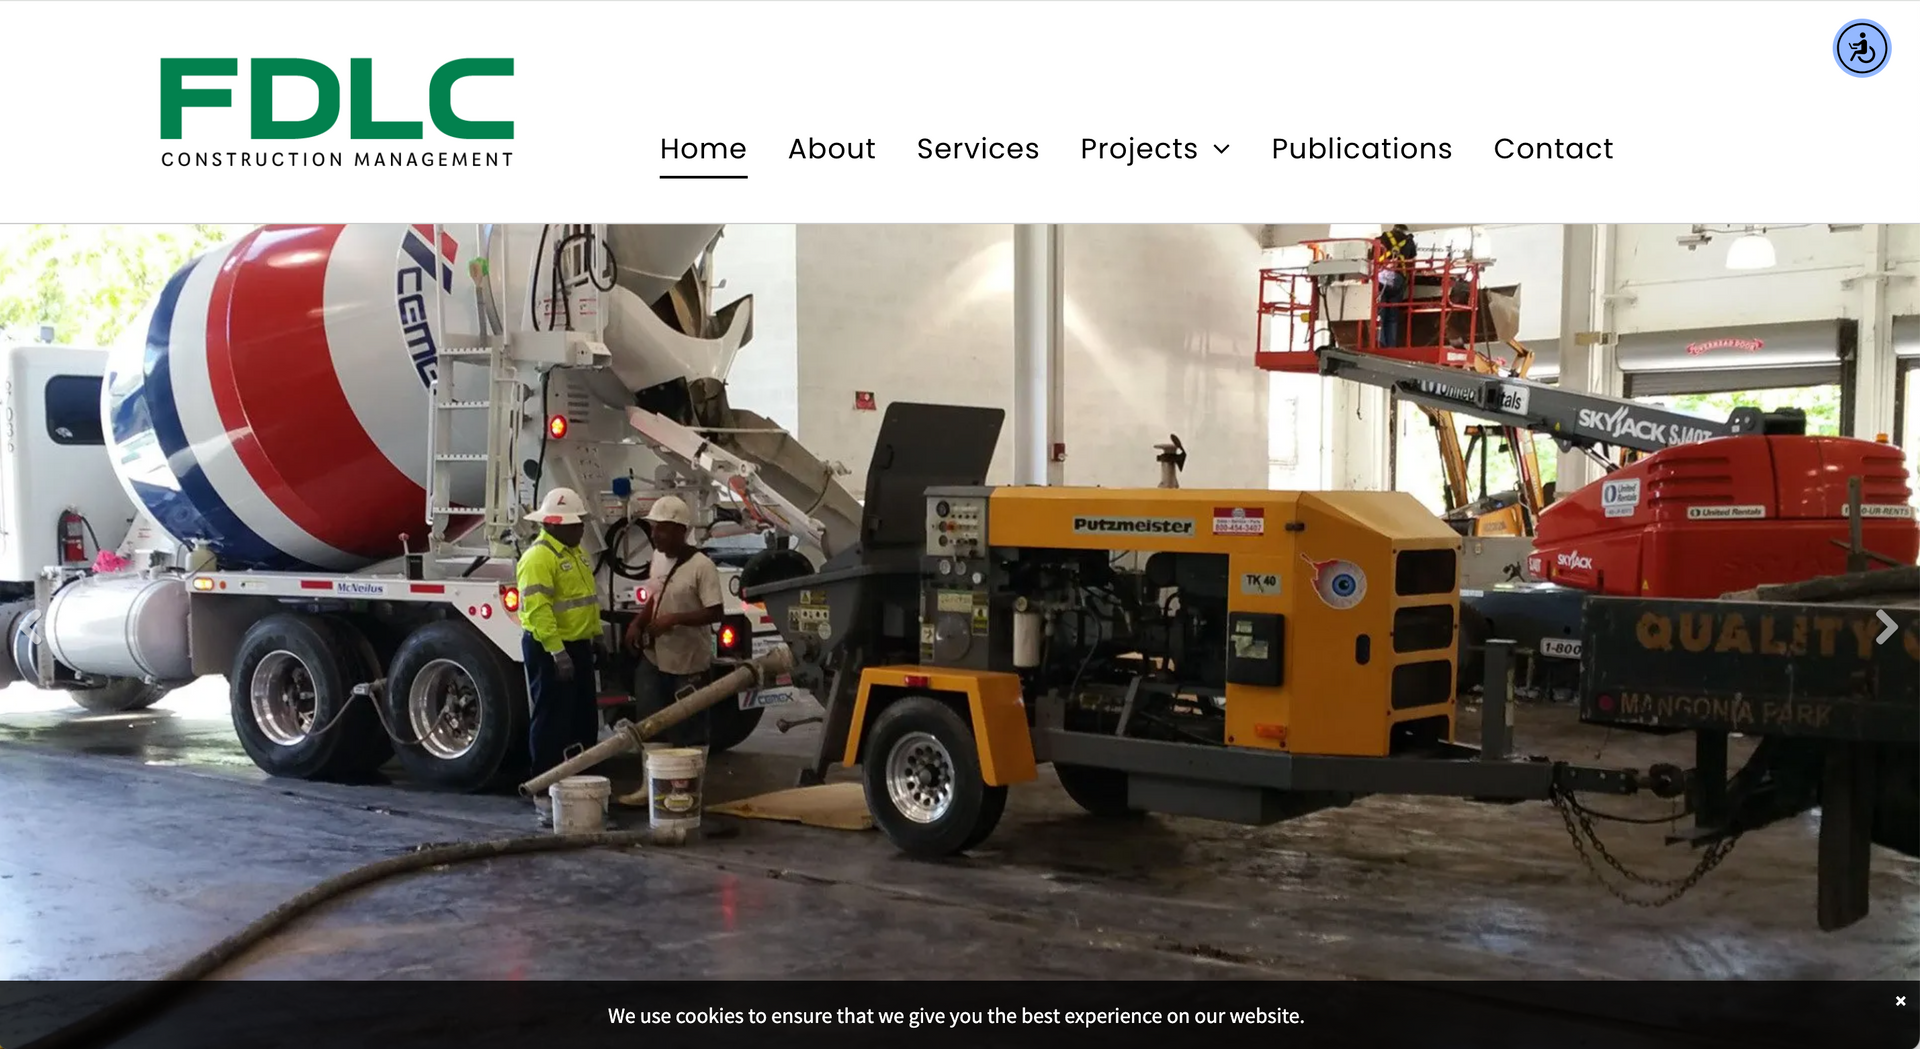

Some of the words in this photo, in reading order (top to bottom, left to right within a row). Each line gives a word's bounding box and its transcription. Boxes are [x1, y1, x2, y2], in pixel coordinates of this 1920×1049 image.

[398, 266, 439, 389] CEME
[1578, 405, 1667, 444] SKYJACK
[1617, 483, 1637, 493] United
[1702, 508, 1731, 517] United
[1732, 507, 1762, 516] Rentals
[1074, 518, 1192, 534] Putzmeister
[337, 582, 384, 594] McNeilus
[1246, 575, 1262, 586] TK
[1263, 576, 1277, 587] 40
[1635, 611, 1881, 661] QUALITY
[1620, 691, 1754, 725] MANGONIA
[1762, 701, 1834, 728] PARK
